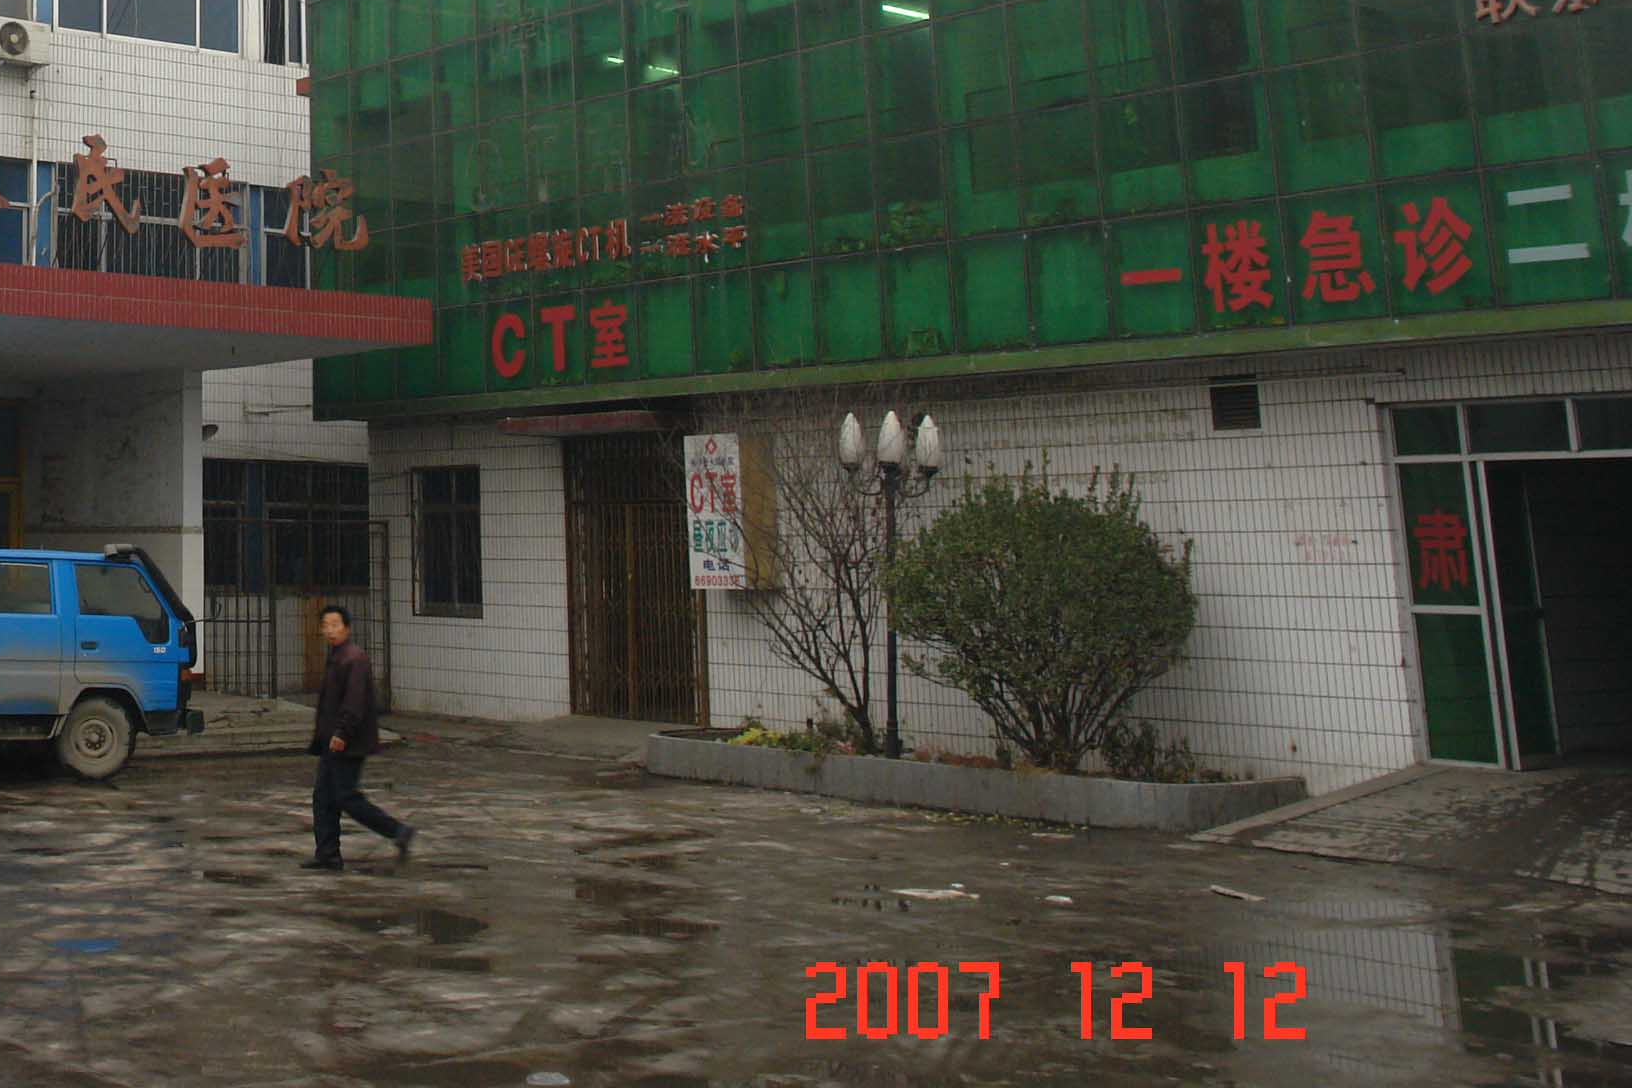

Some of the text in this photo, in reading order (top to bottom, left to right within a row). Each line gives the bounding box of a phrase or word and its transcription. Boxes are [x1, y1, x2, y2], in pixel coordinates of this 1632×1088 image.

[1120, 196, 1474, 314] 一楼急诊
[492, 299, 631, 379] CT室
[690, 472, 737, 513] CT室
[1413, 510, 1467, 592] 肃
